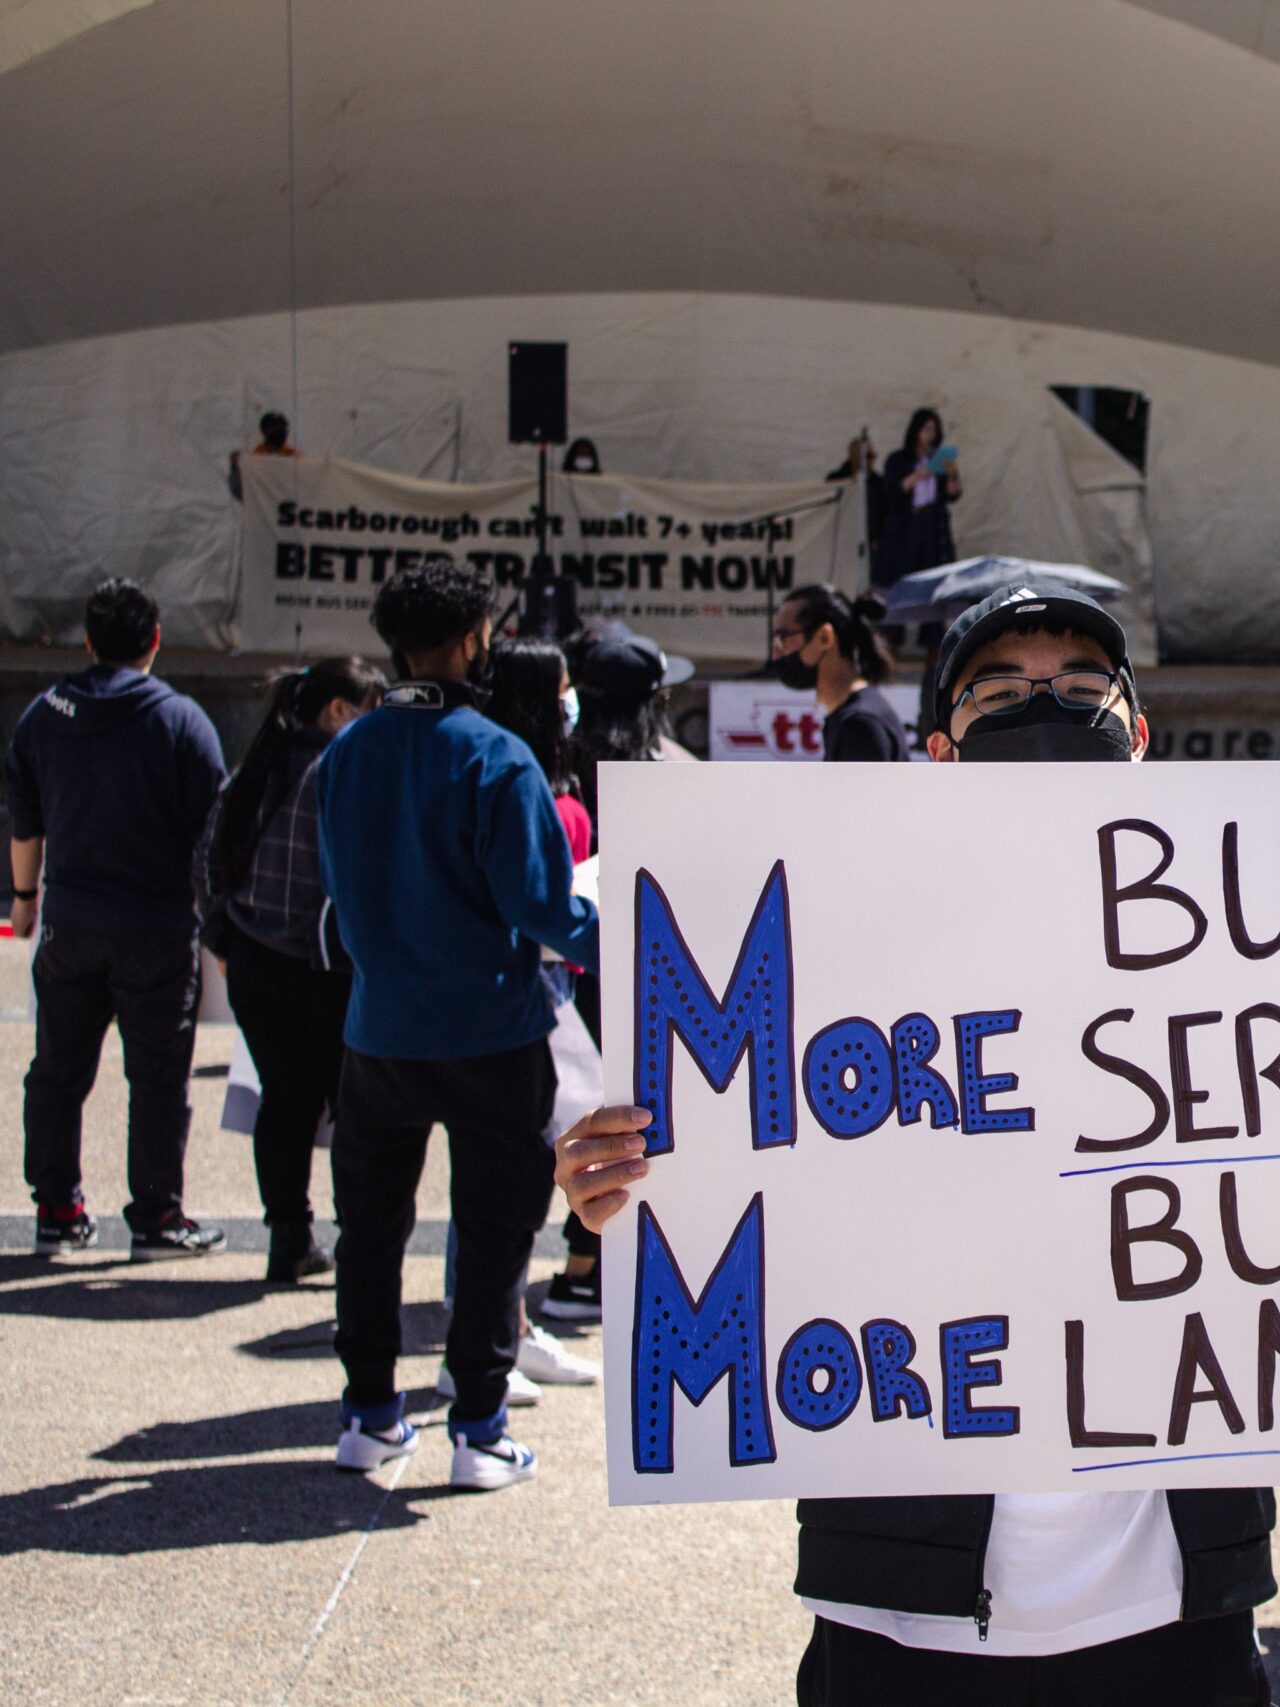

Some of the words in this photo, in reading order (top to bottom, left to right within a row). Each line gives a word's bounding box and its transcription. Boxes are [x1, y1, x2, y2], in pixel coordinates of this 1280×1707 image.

[277, 500, 480, 542] Scarborough
[488, 505, 564, 538] can't
[579, 512, 648, 538] wait
[657, 515, 692, 538] 7+
[702, 516, 793, 546] years!
[681, 554, 796, 590] NOW
[1149, 727, 1275, 759] uare
[635, 859, 1036, 1155] MORE
[634, 1191, 1020, 1474] MORE
